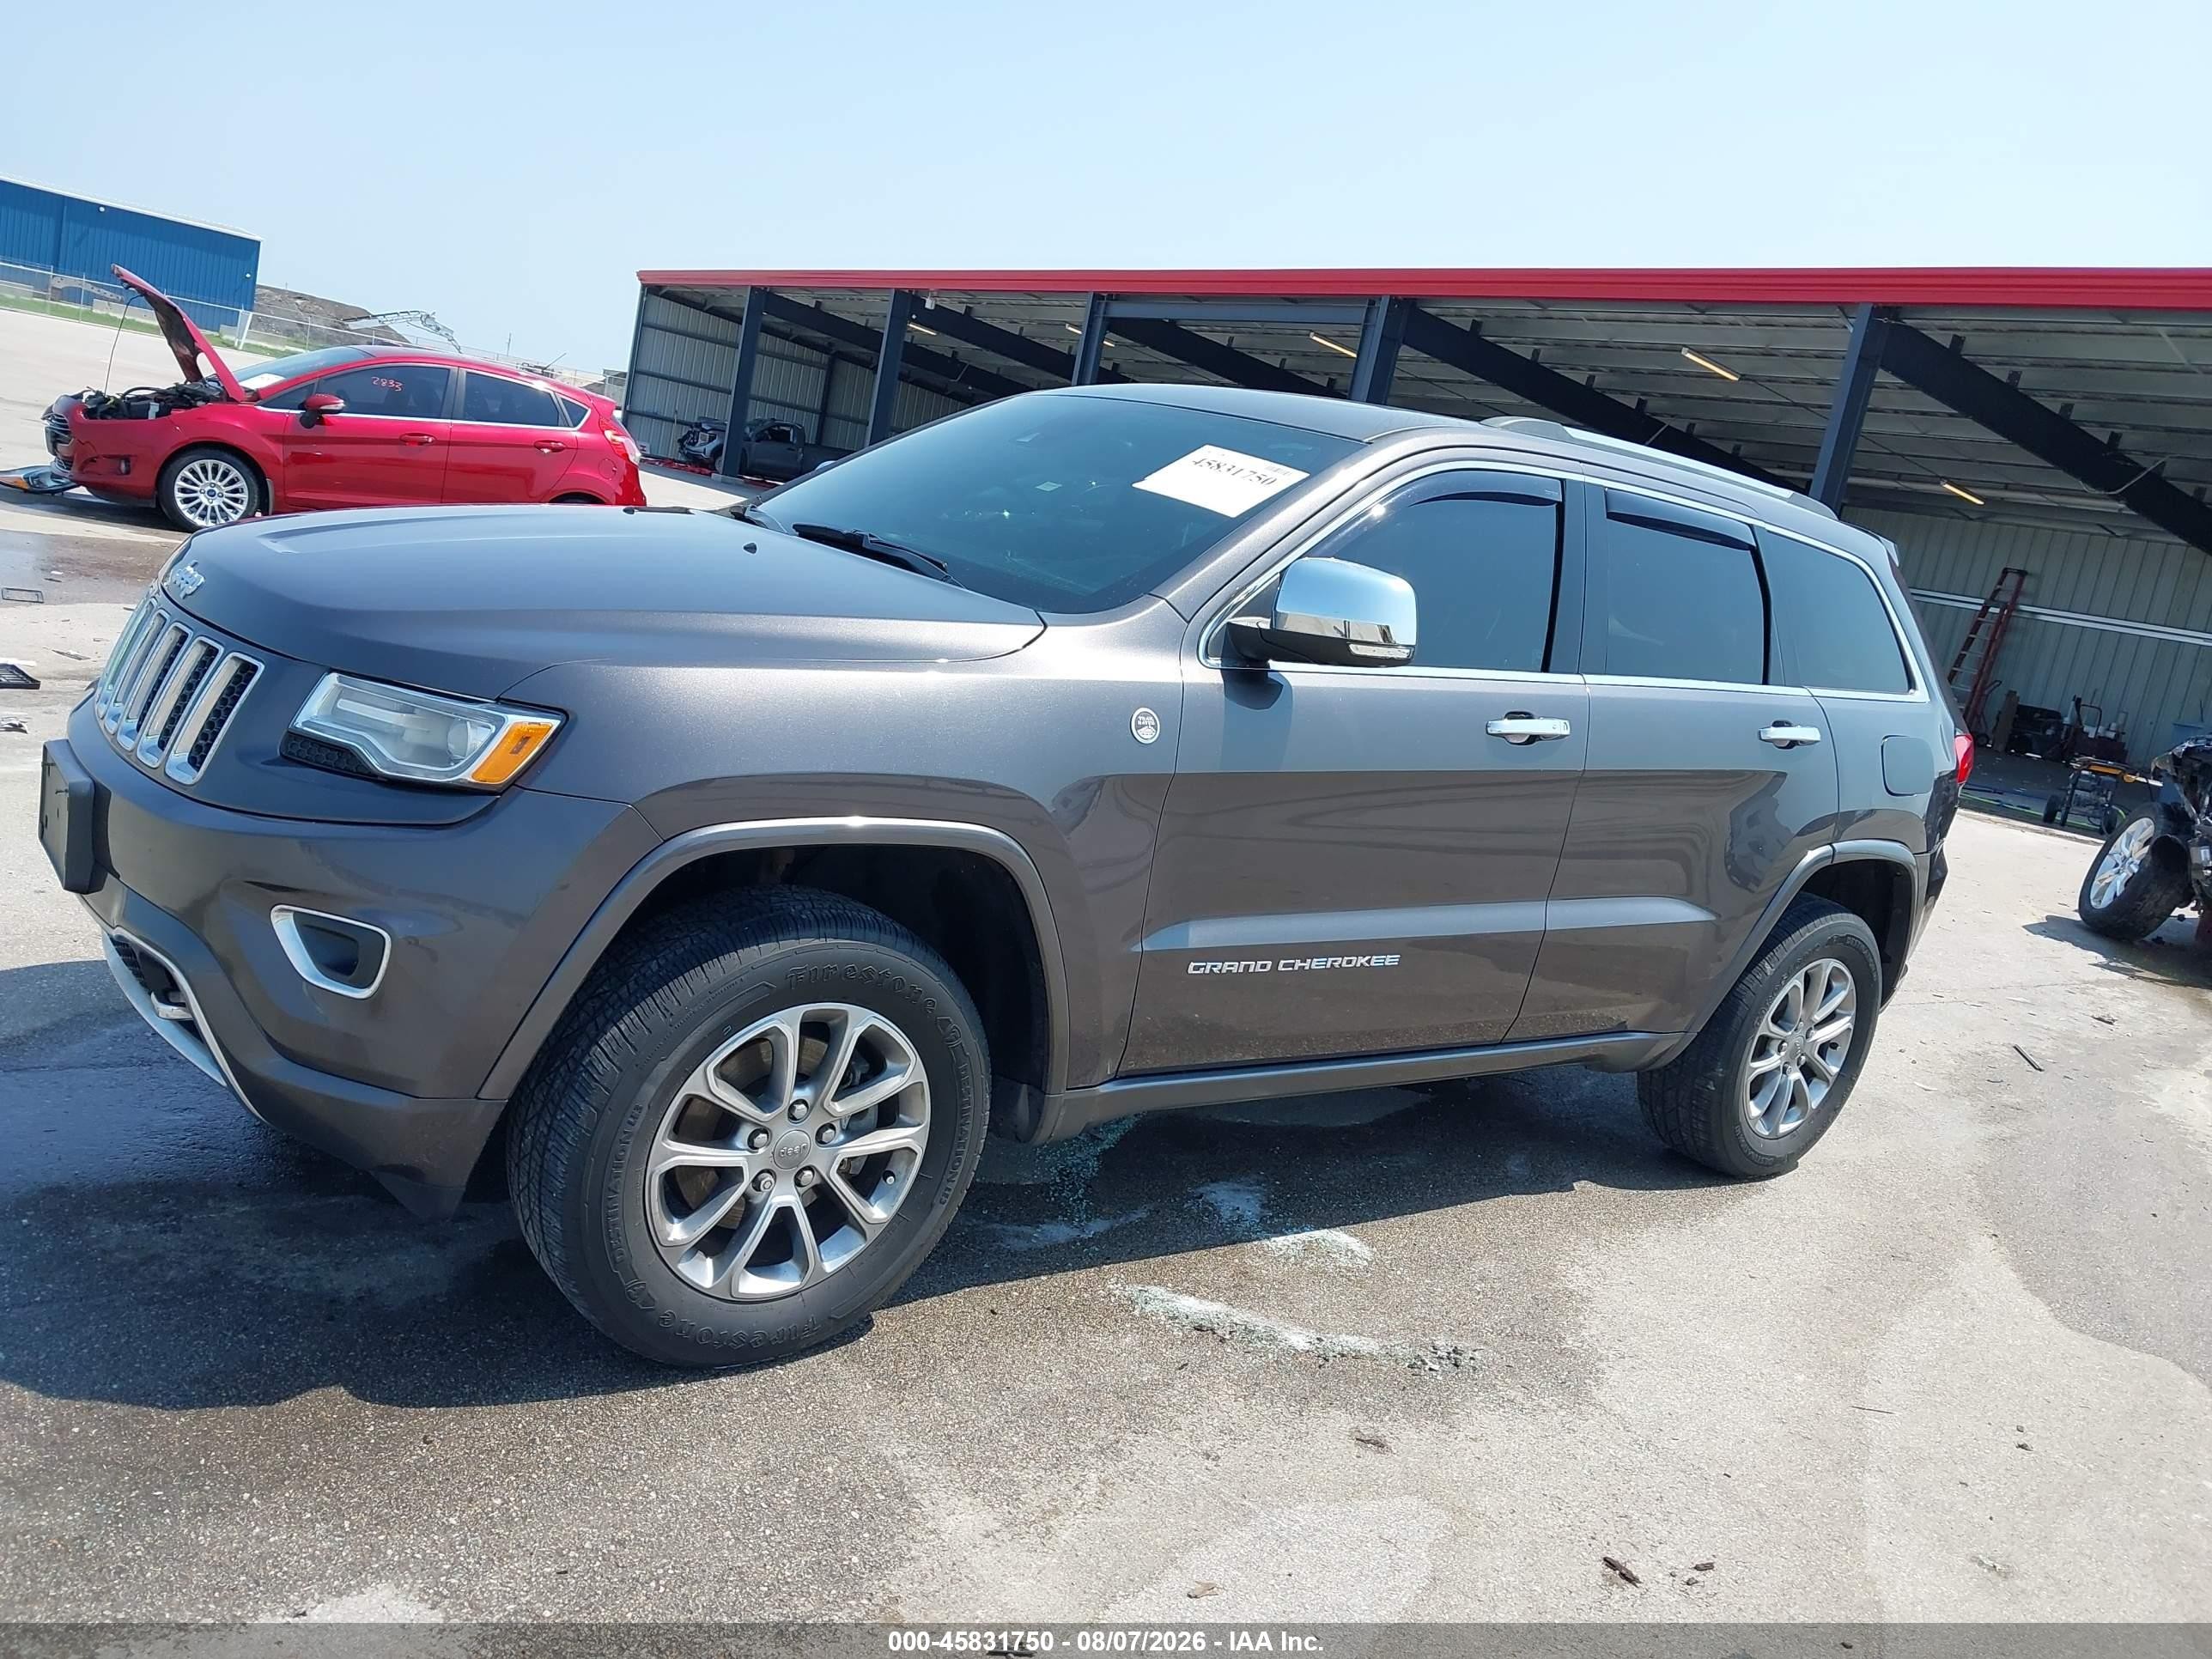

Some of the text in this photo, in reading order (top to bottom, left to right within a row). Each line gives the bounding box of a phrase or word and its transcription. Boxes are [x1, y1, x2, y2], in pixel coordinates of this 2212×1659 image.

[371, 376, 403, 392] 2833
[1192, 458, 1277, 485] 45831750
[1187, 954, 1401, 974] GRAND CHEROKEE
